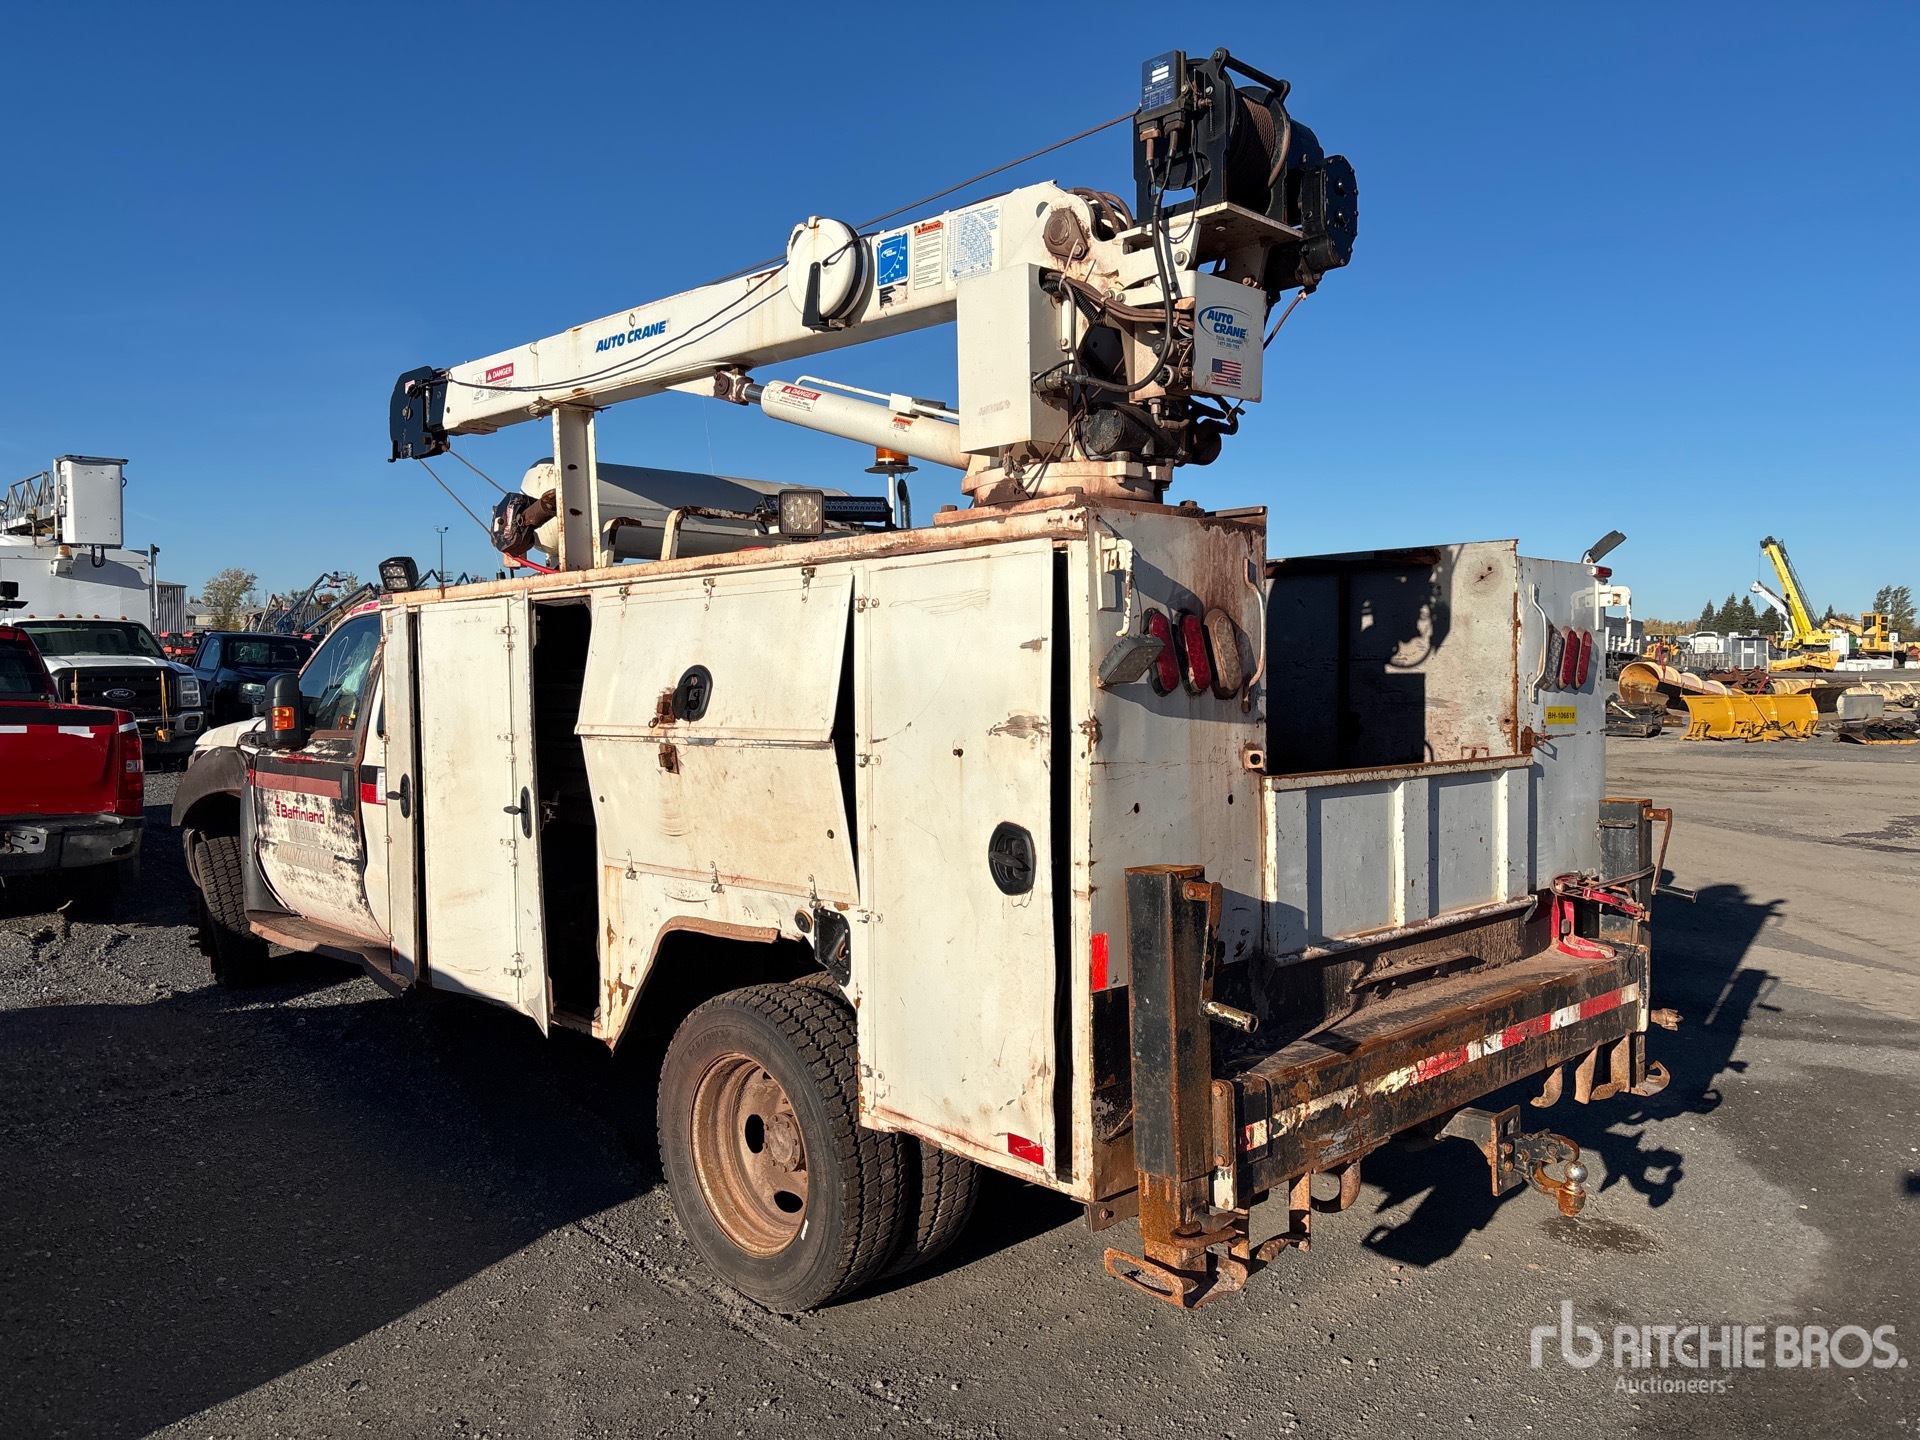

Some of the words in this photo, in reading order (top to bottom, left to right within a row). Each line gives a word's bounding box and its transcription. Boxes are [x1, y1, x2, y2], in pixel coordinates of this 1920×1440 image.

[1207, 310, 1233, 324] AUTO
[596, 333, 626, 353] AUTO
[627, 320, 667, 344] CRANE
[1214, 323, 1247, 339] CRANE
[492, 366, 513, 379] DANGER
[791, 389, 816, 399] DANGER
[281, 804, 325, 824] Baffinland
